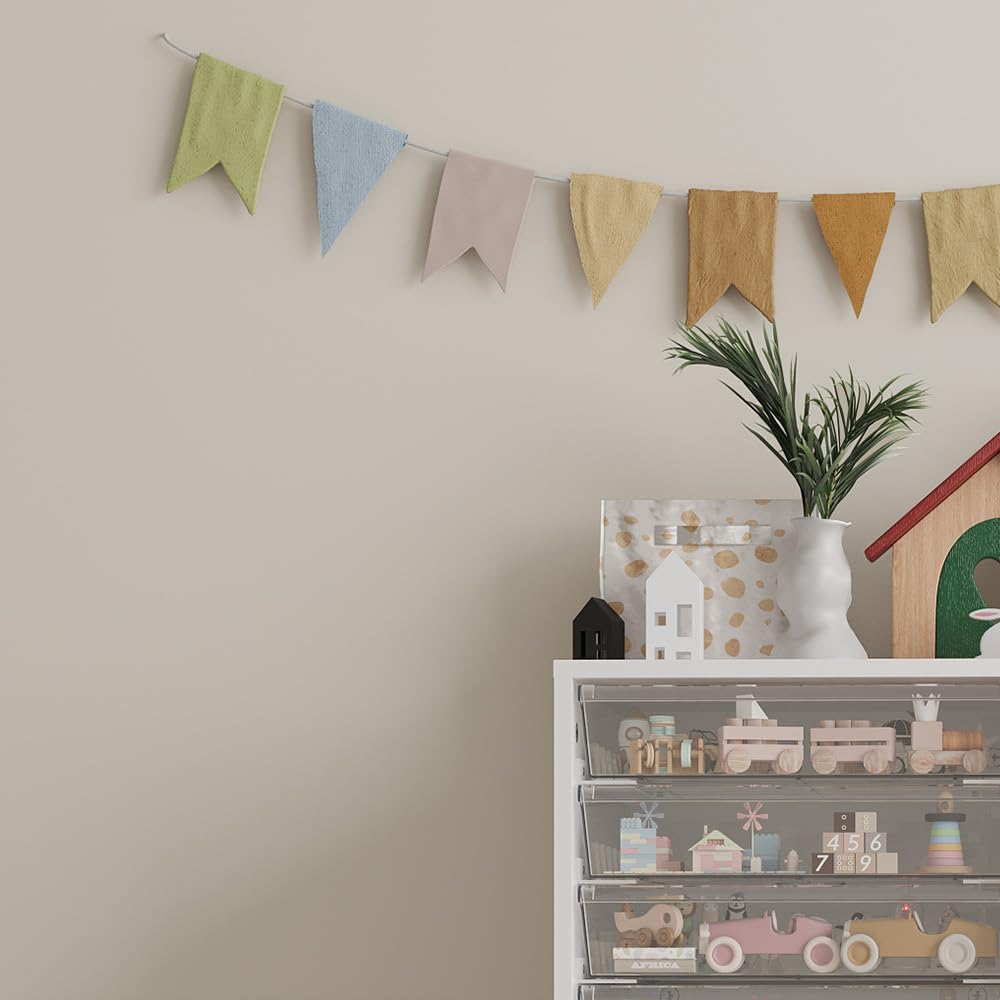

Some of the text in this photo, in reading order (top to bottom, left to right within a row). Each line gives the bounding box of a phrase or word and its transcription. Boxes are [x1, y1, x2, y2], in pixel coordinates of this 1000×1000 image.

[826, 833, 882, 852] 4 5 6
[815, 855, 829, 872] 7
[860, 855, 872, 872] 9
[631, 961, 680, 969] AFRICA
